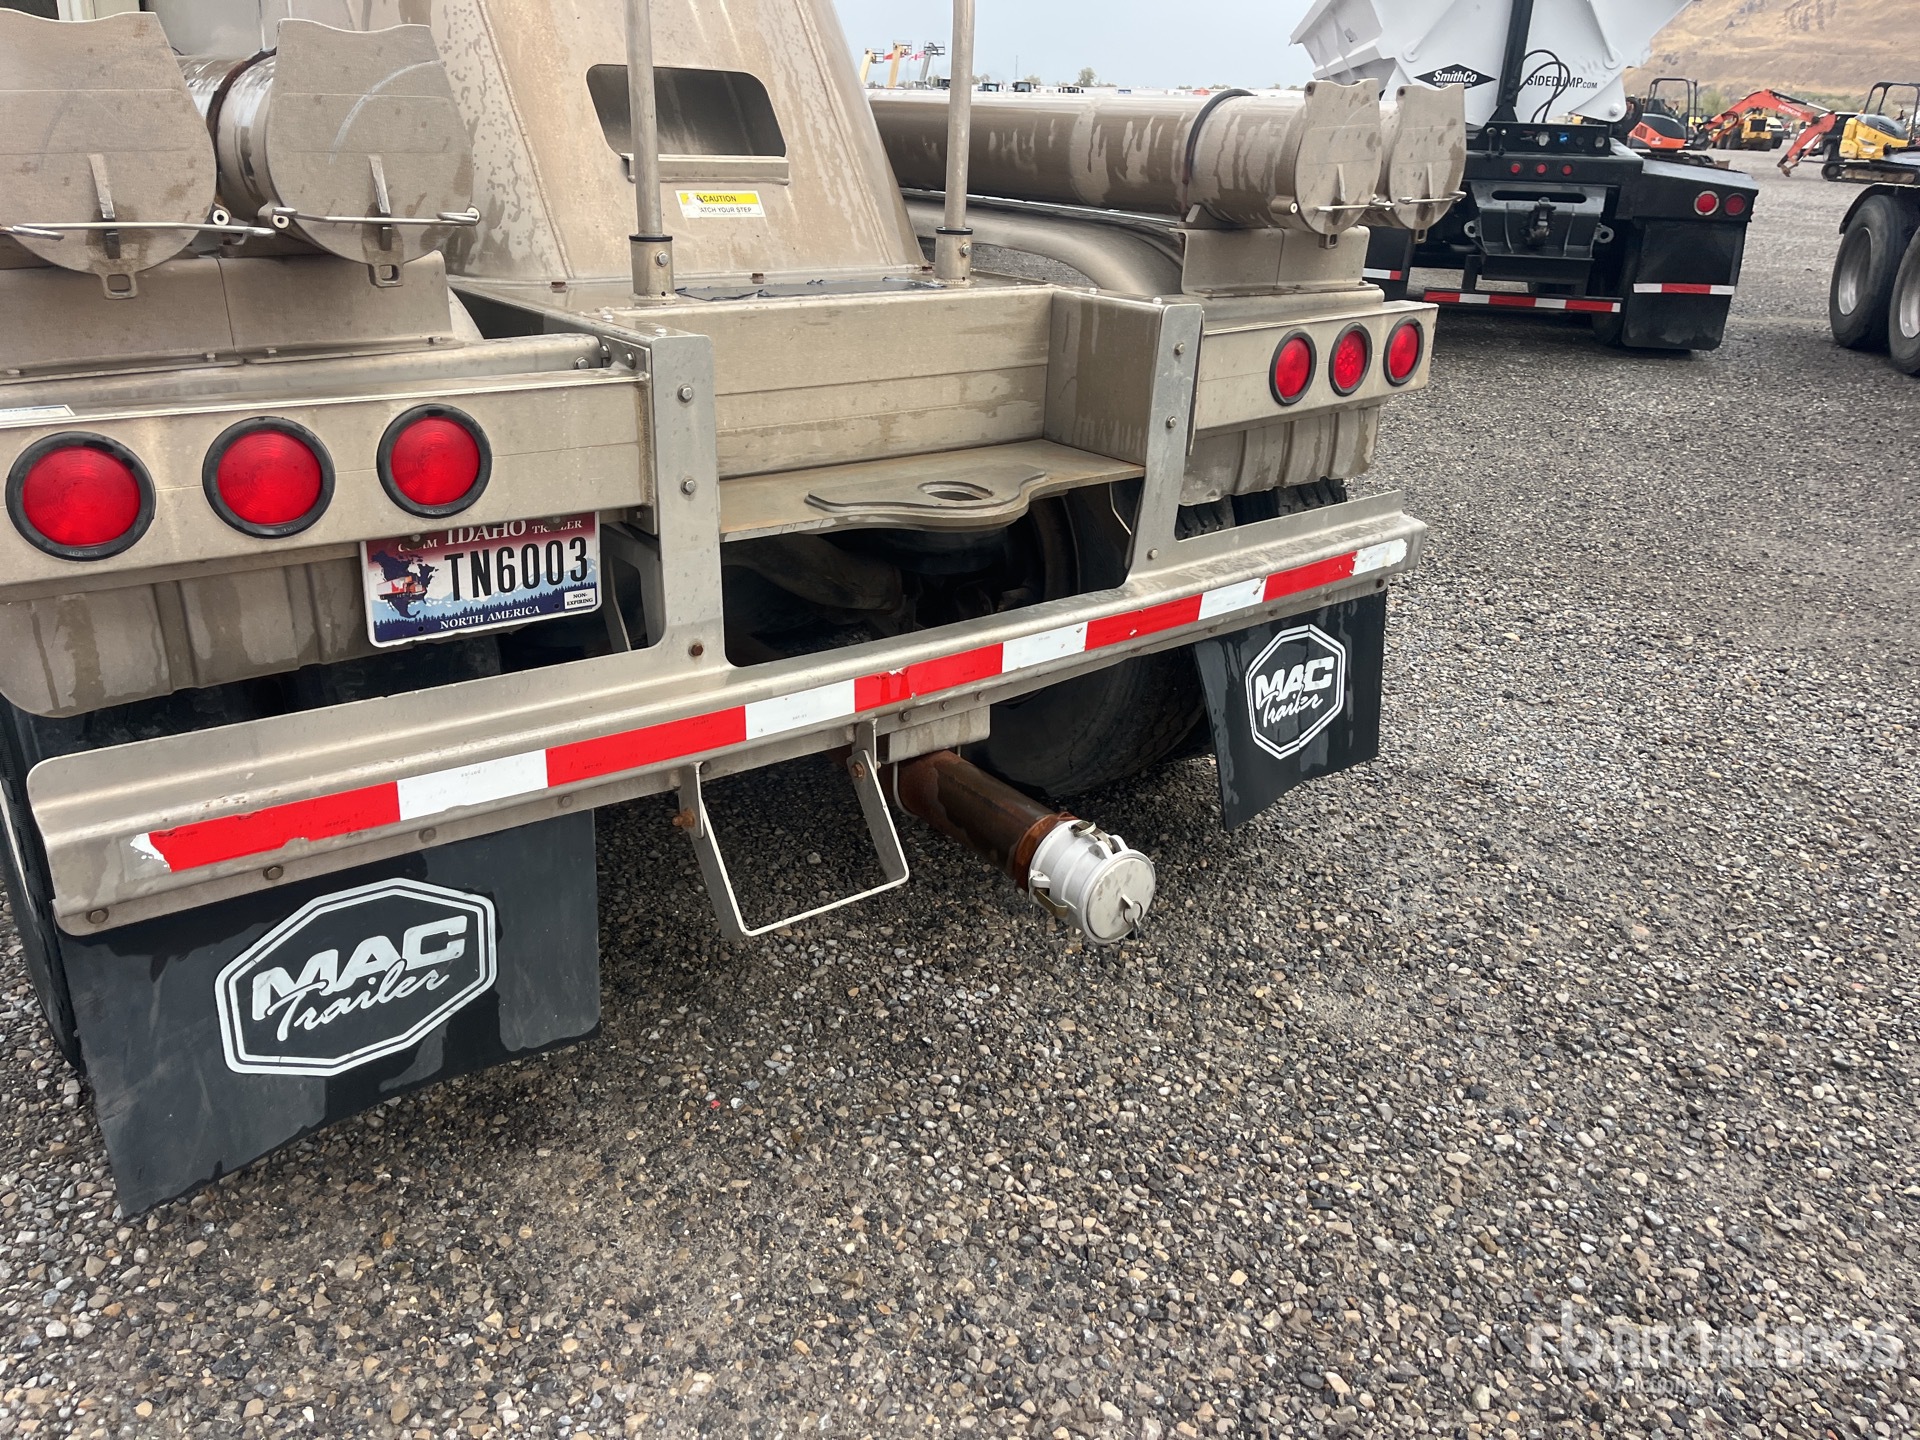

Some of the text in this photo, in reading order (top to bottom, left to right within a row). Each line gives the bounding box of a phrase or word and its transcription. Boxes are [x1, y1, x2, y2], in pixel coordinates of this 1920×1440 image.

[1433, 70, 1477, 83] SmithCo
[1777, 104, 1802, 117] HITACHI
[445, 520, 527, 546] IDAHO
[444, 536, 588, 602] TN6003
[440, 605, 541, 630] NORTH AMERICA
[566, 597, 594, 606] EXPIRING
[1255, 656, 1335, 710] MAC
[1259, 683, 1324, 728] Trailer
[252, 915, 468, 1021] MAC
[267, 958, 450, 1042] Trailer
